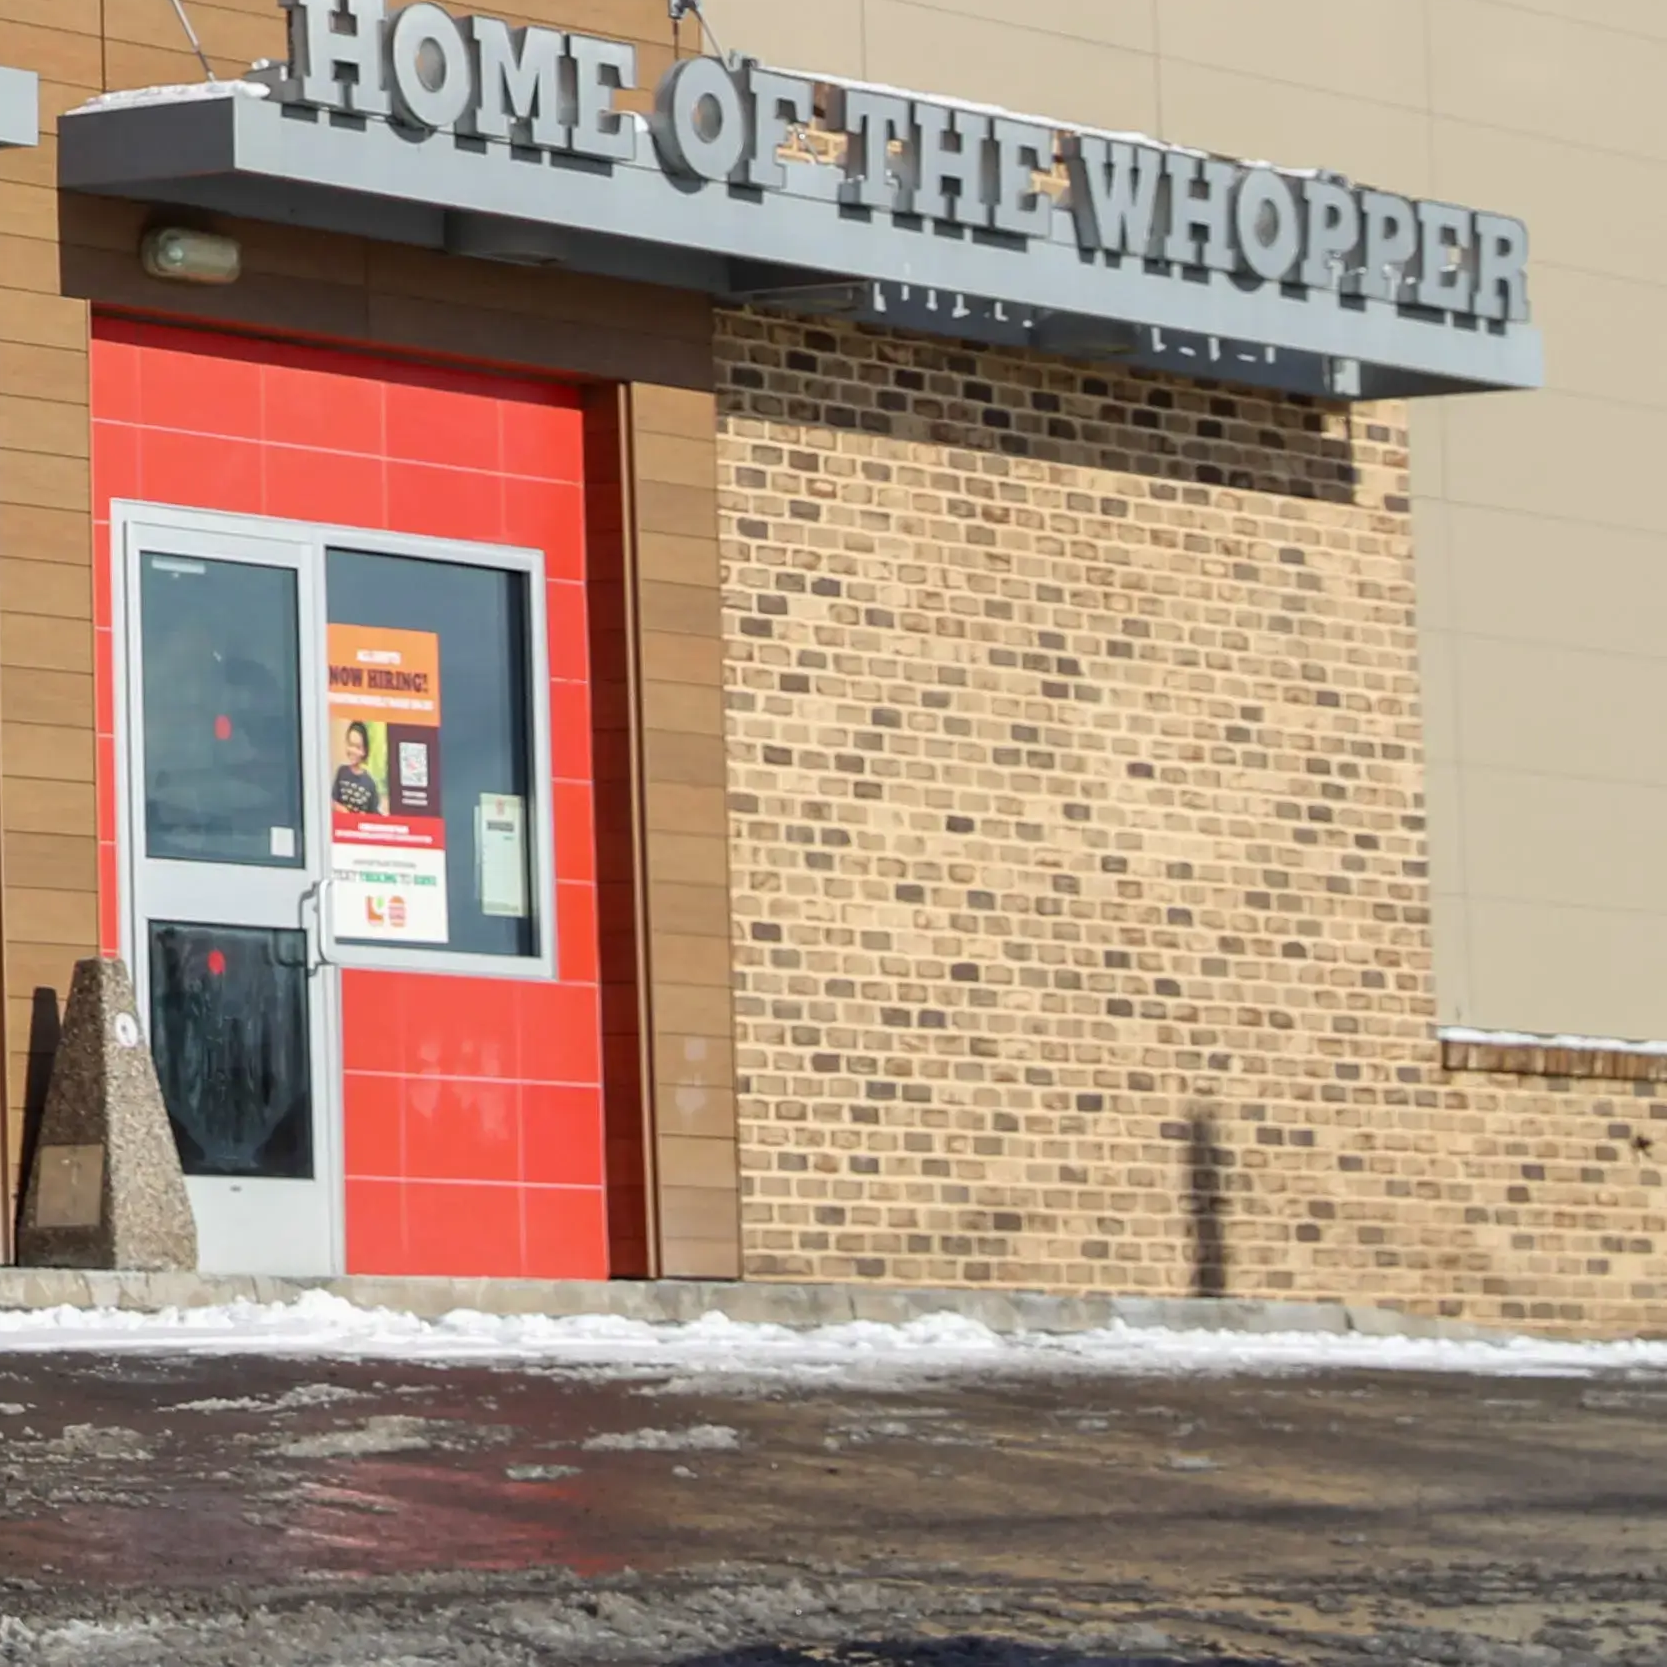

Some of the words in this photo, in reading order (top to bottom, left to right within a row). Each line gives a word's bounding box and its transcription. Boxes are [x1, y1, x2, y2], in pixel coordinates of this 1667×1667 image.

[657, 54, 814, 191] OF
[837, 89, 1055, 239] THE
[1072, 134, 1531, 323] WHOPPER
[328, 665, 363, 688] NOW
[368, 668, 429, 694] HIRING!
